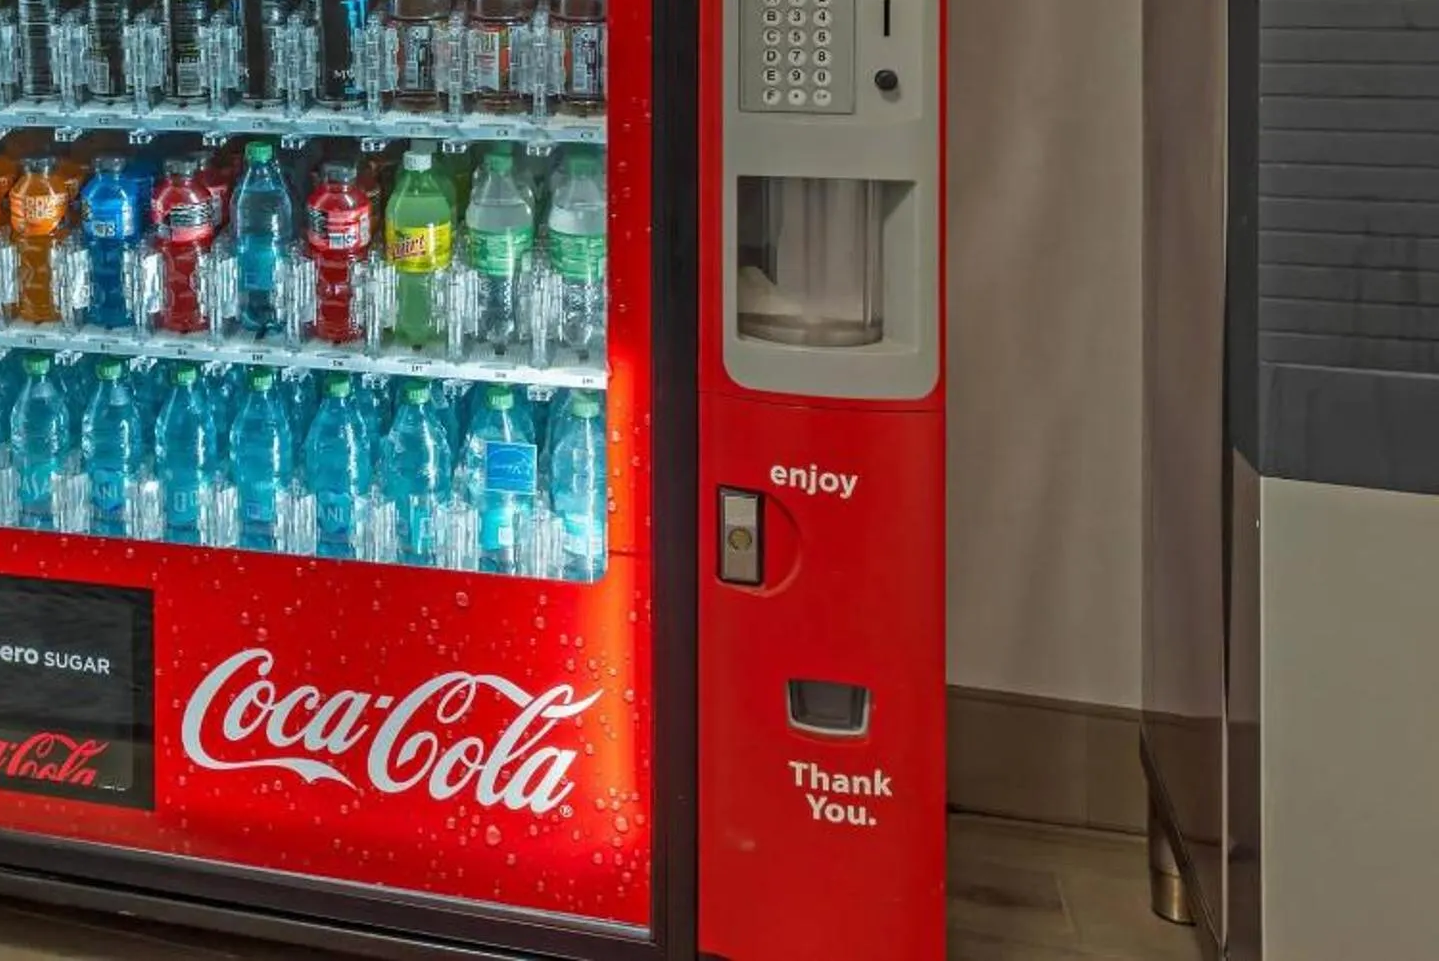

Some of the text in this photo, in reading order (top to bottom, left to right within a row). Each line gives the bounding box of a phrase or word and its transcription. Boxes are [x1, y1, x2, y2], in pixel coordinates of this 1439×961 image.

[767, 10, 776, 21] B
[767, 30, 776, 41] C
[767, 51, 776, 62] D
[767, 70, 776, 80] E
[767, 89, 775, 100] F
[770, 464, 859, 500] enjoy
[44, 651, 110, 675] SUGAR
[181, 647, 604, 815] Coca-Cola
[788, 760, 892, 796] Thank
[806, 794, 877, 826] You.
